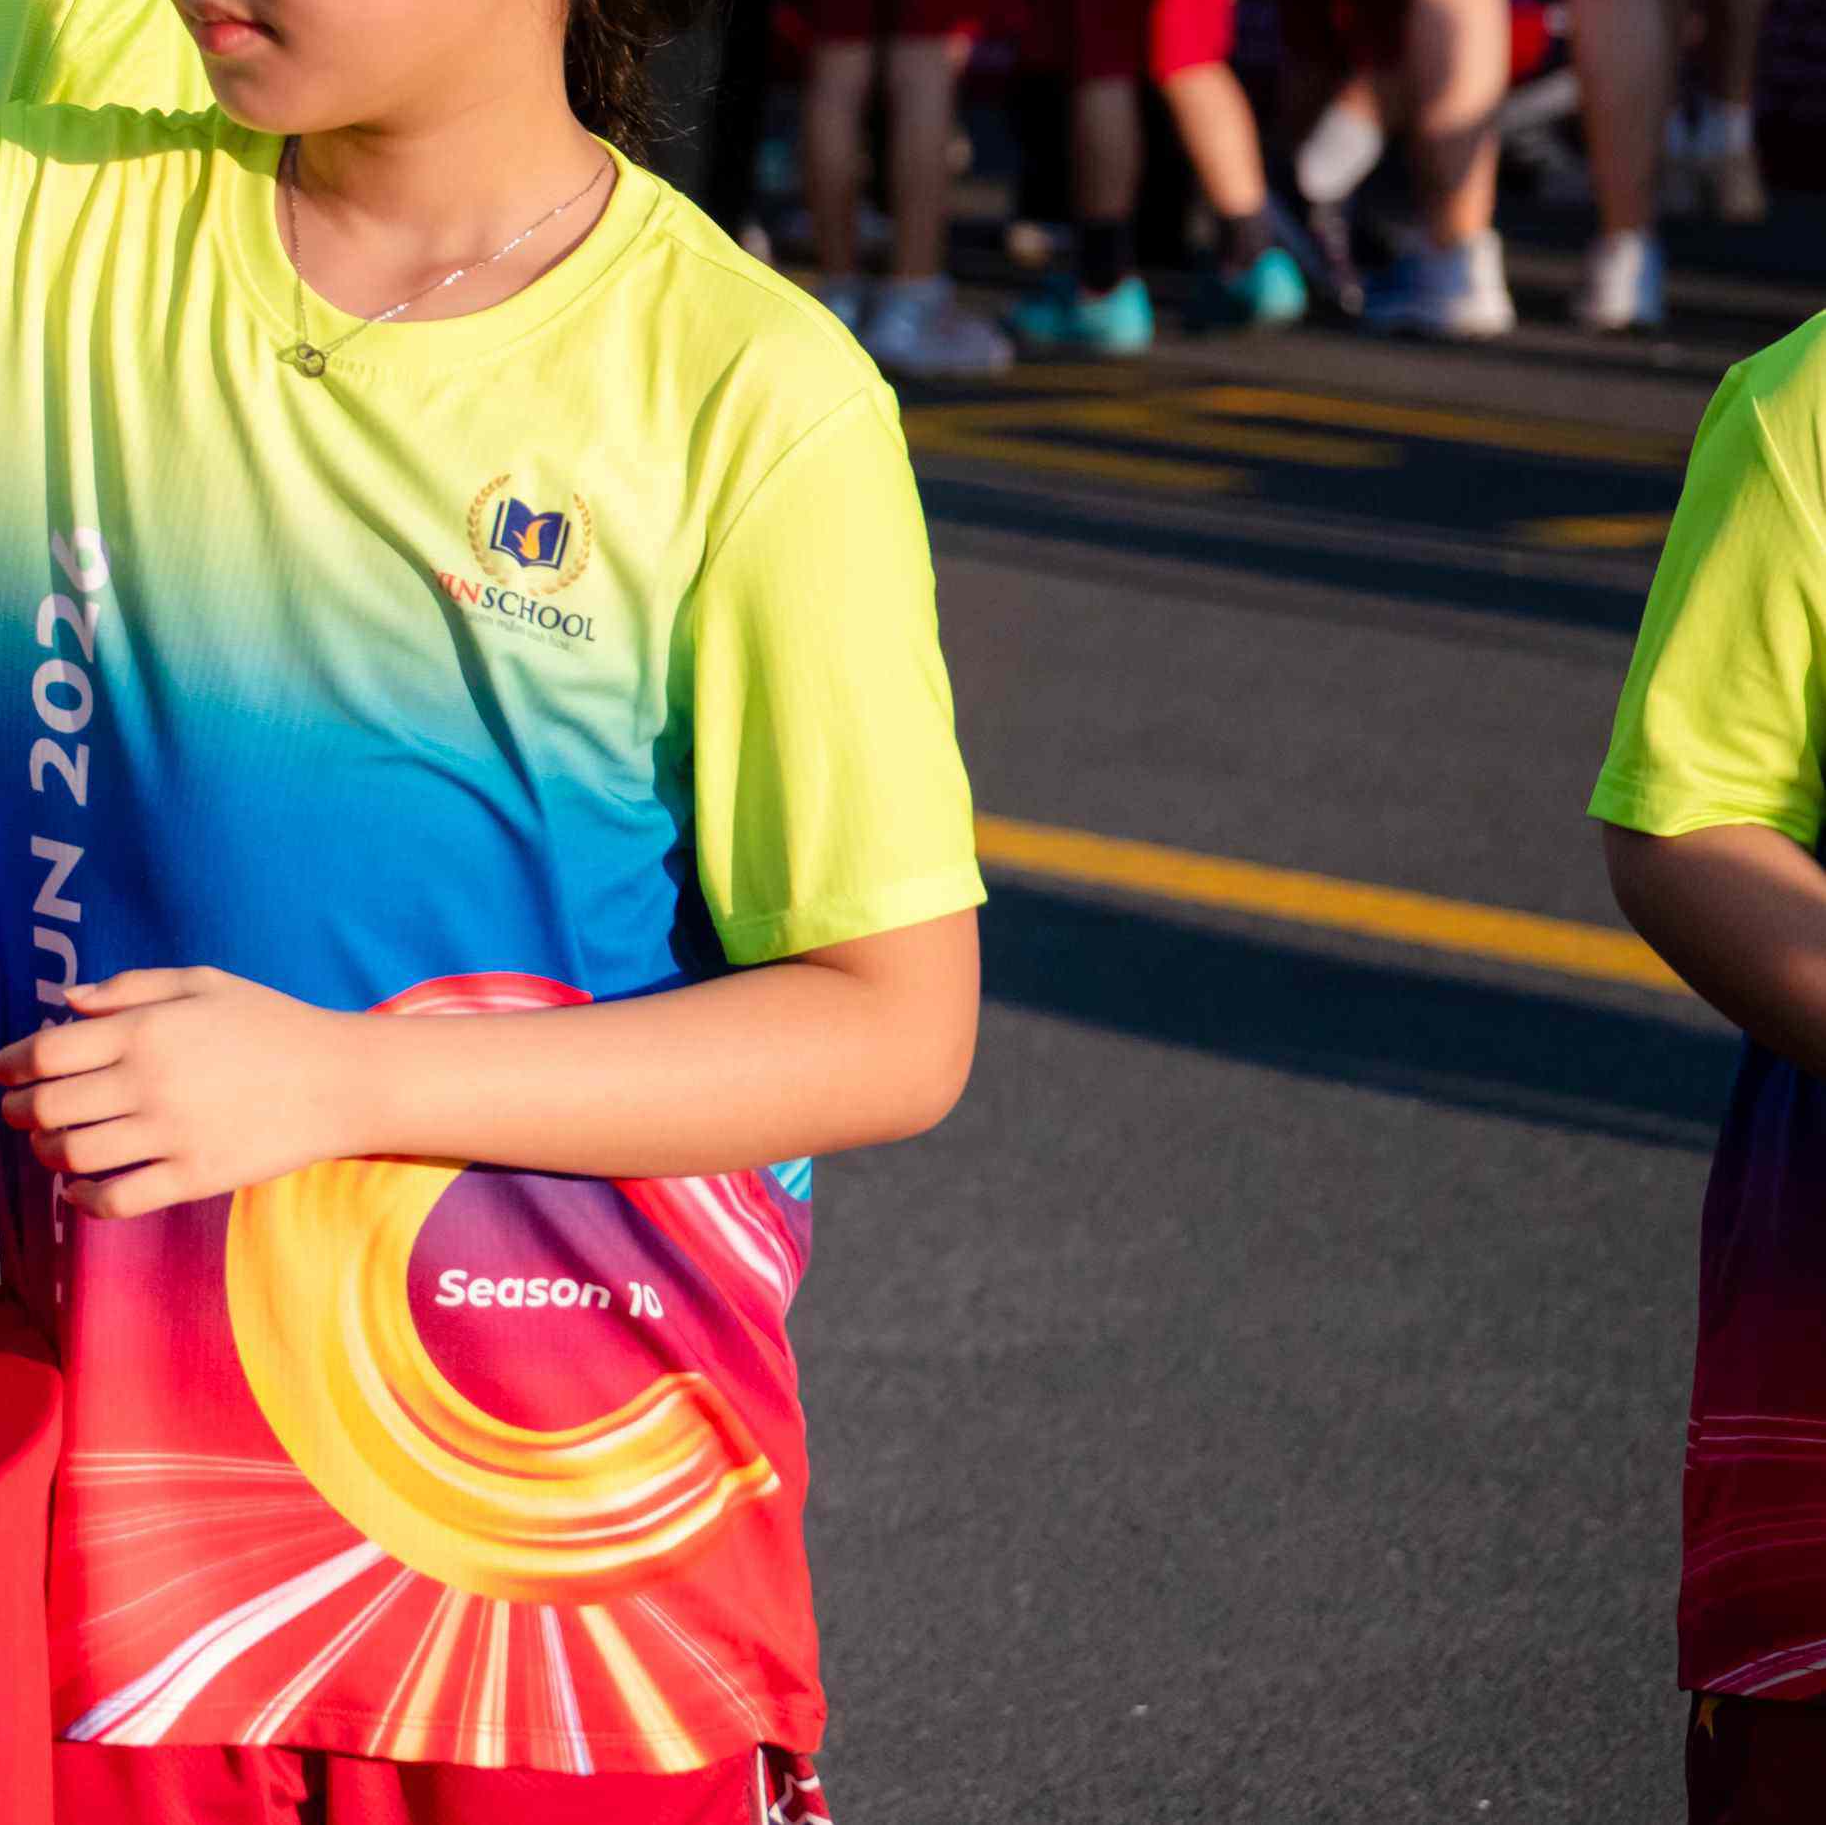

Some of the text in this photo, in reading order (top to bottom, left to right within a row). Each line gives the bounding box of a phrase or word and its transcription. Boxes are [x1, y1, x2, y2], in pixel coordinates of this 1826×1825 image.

[28, 526, 111, 807] 2026
[434, 1269, 665, 1319] Season 10
